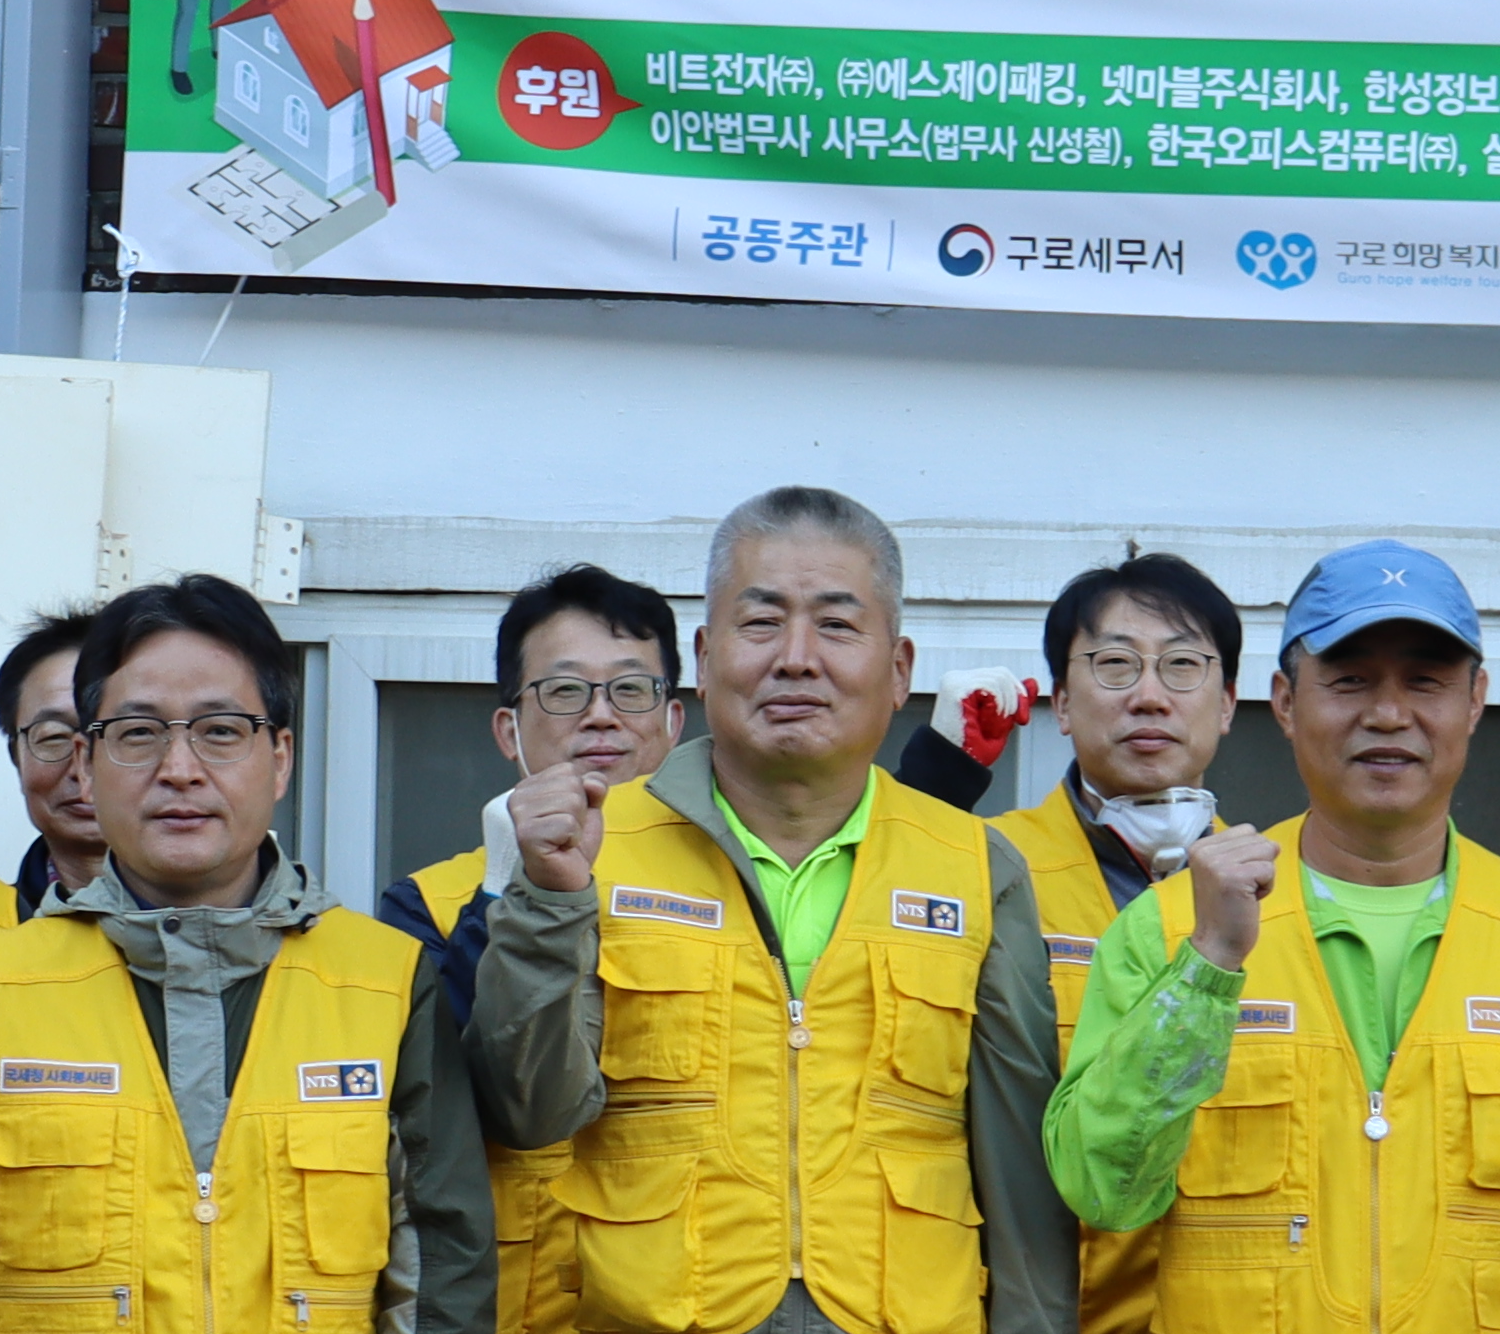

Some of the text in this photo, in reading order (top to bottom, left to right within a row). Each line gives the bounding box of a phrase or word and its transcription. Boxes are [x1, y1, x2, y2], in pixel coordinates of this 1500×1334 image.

[514, 64, 600, 118] 후원
[1102, 64, 1350, 115] 넷마블주식회사,
[651, 111, 809, 157] 이안법무사
[702, 213, 868, 267] 공동주관
[1006, 235, 1183, 275] 구로세무서
[898, 903, 926, 918] NTS
[306, 1074, 338, 1088] NTS
